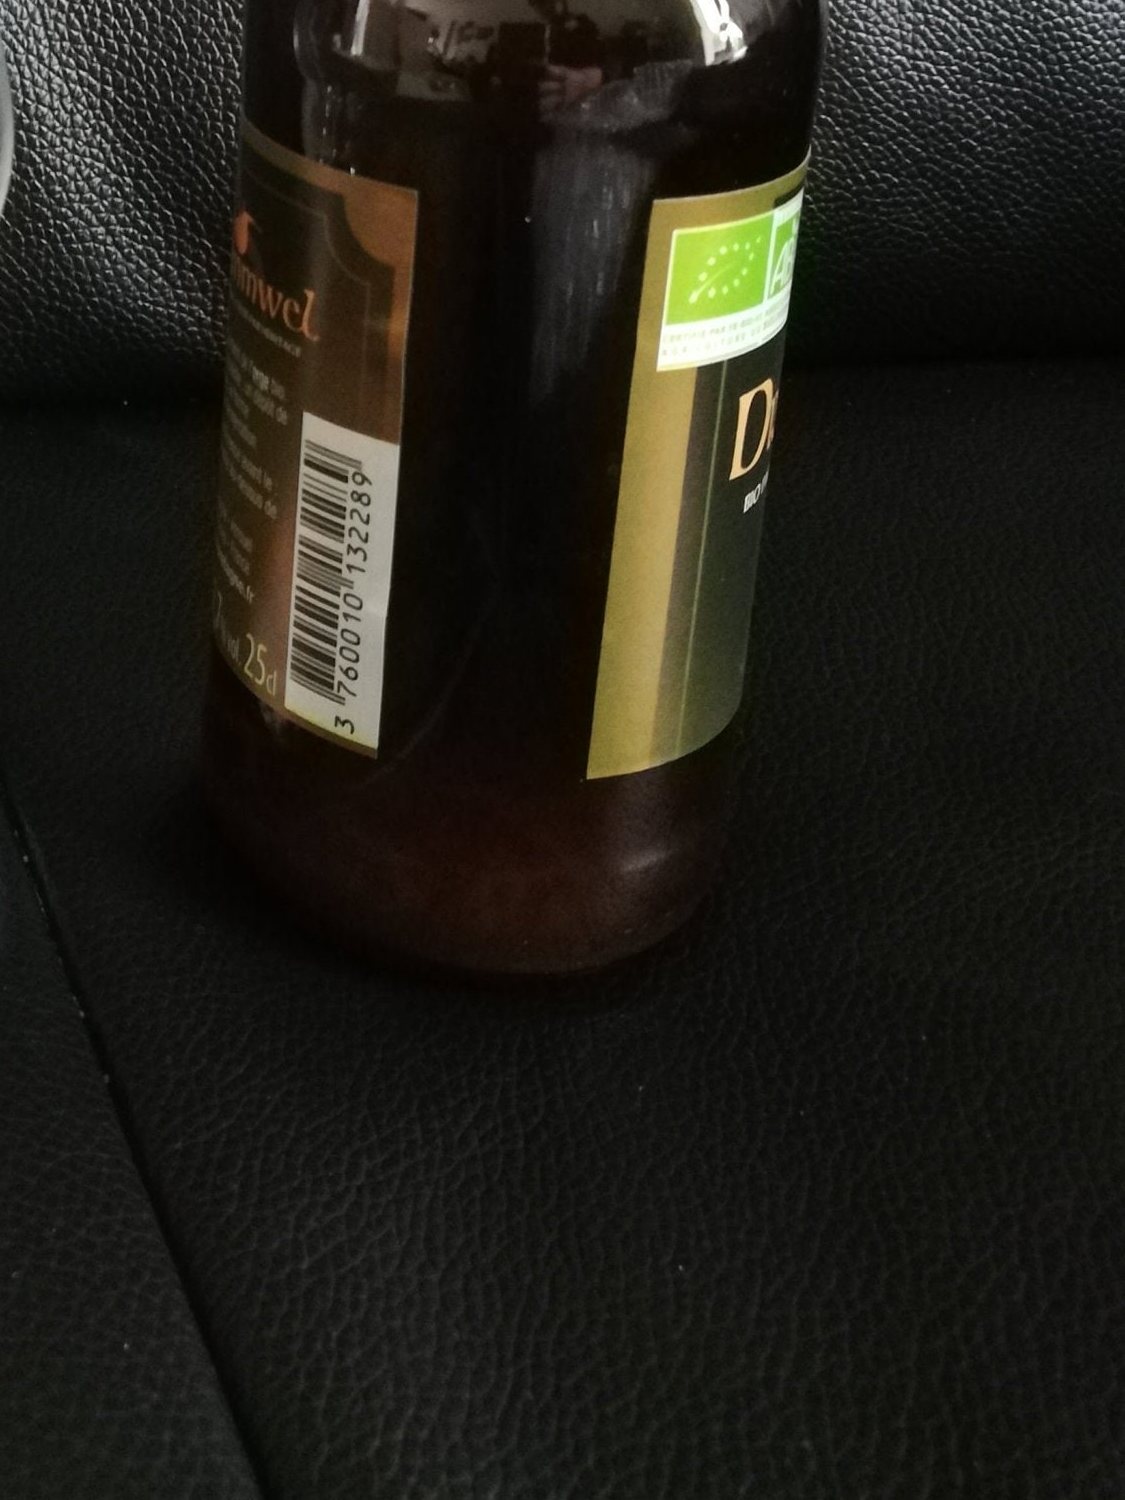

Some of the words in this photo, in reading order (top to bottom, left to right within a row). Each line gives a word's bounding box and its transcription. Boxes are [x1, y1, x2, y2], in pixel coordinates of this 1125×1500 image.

[345, 470, 373, 575] 132289
[336, 591, 364, 698] 760010
[334, 715, 356, 735] 3
